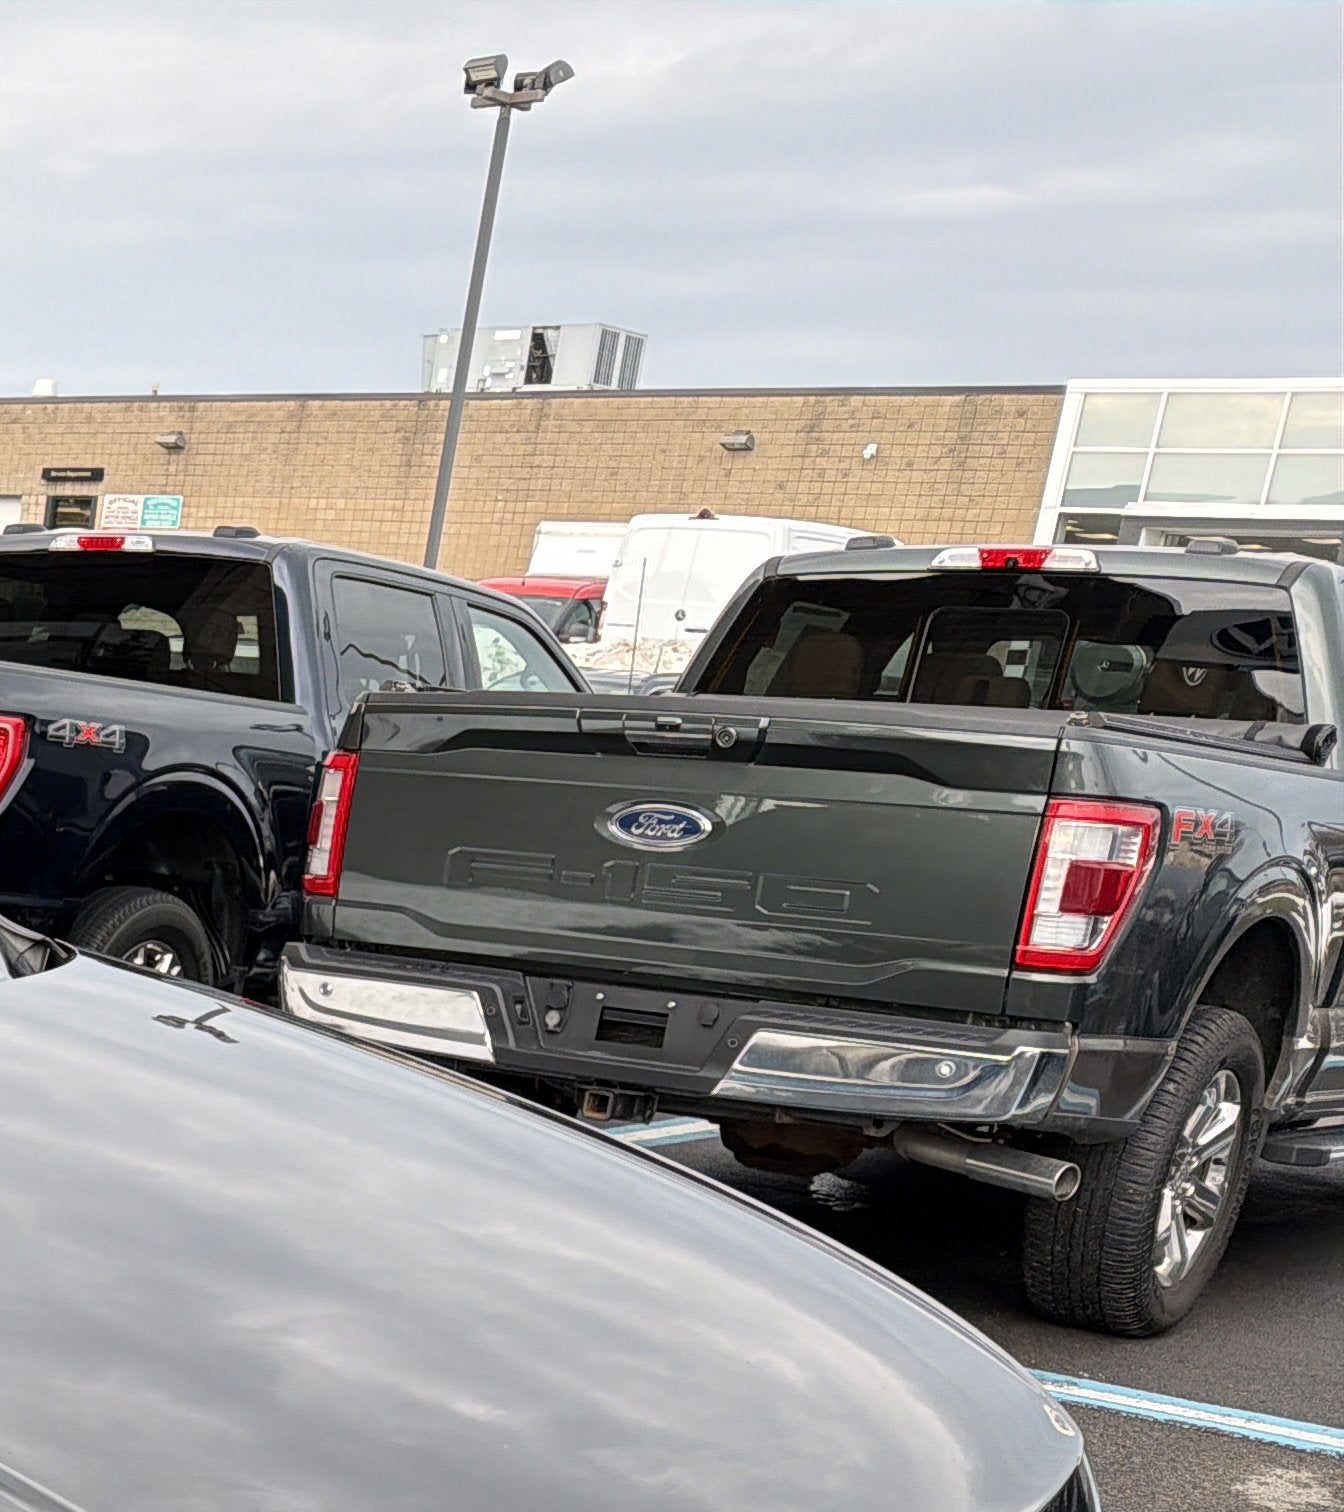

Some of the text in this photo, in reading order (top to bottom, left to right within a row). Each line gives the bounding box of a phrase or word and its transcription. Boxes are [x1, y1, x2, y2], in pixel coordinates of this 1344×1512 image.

[631, 811, 690, 840] Ford
[1169, 805, 1236, 850] FX4
[443, 846, 881, 926] F-150
